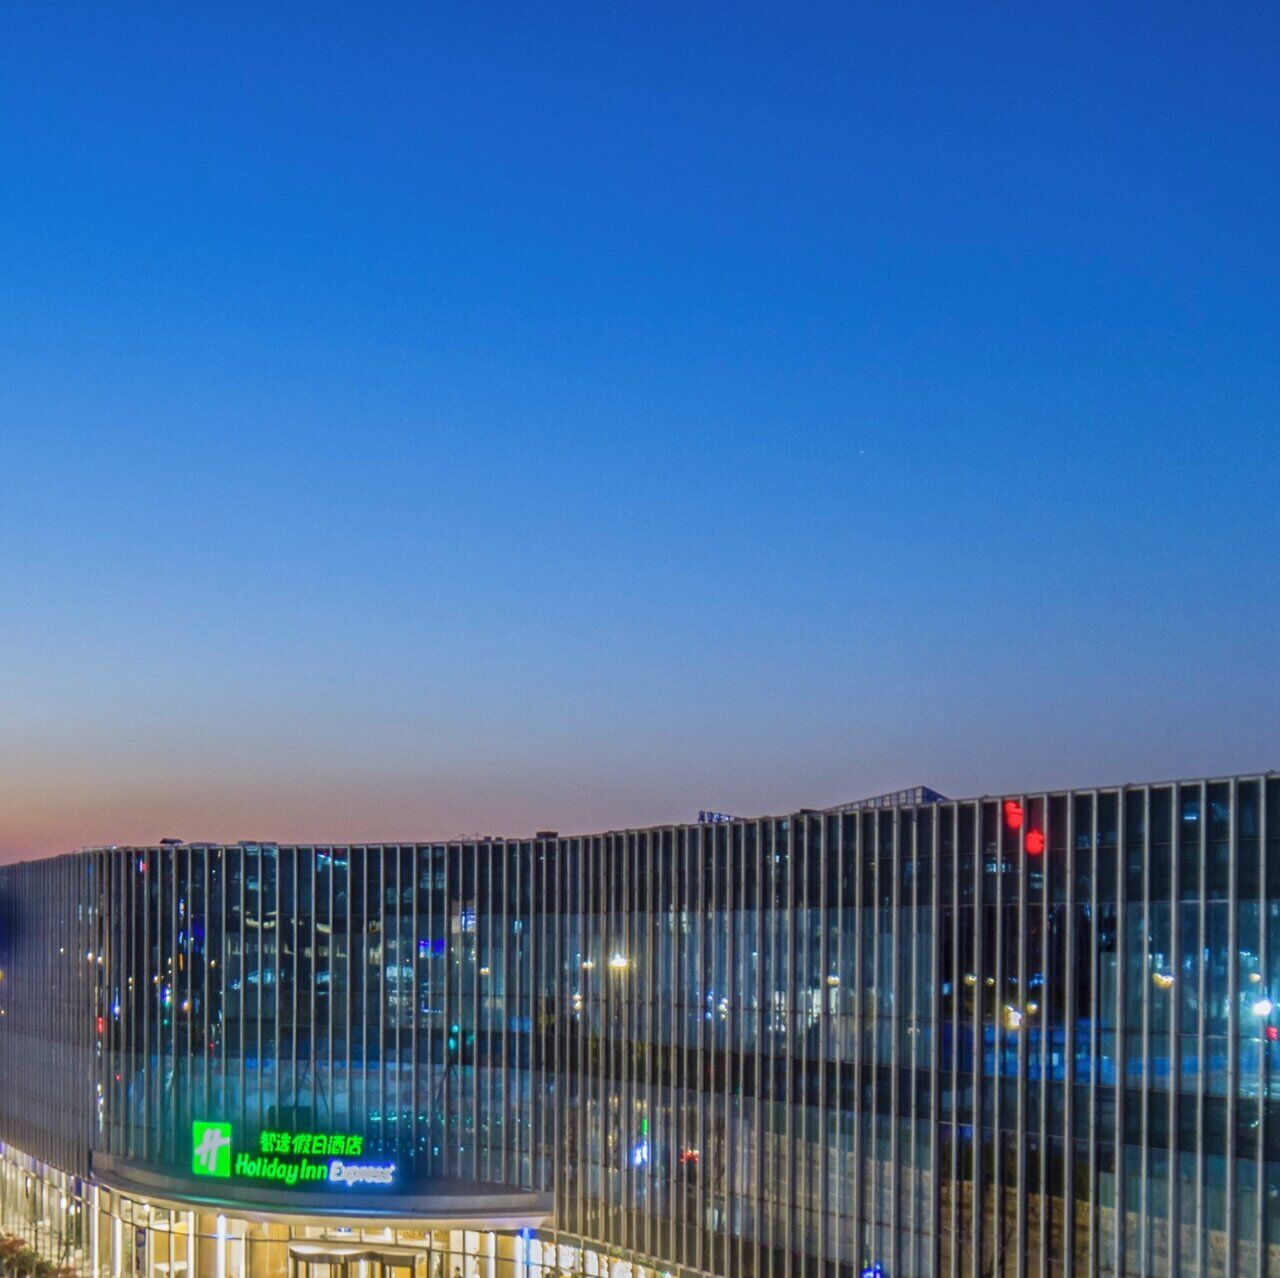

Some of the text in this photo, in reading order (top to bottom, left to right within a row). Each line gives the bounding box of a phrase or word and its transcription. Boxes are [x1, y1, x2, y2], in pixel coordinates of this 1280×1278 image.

[260, 1130, 364, 1156] 智选假日酒店
[235, 1153, 394, 1186] Holiday Inn Express
